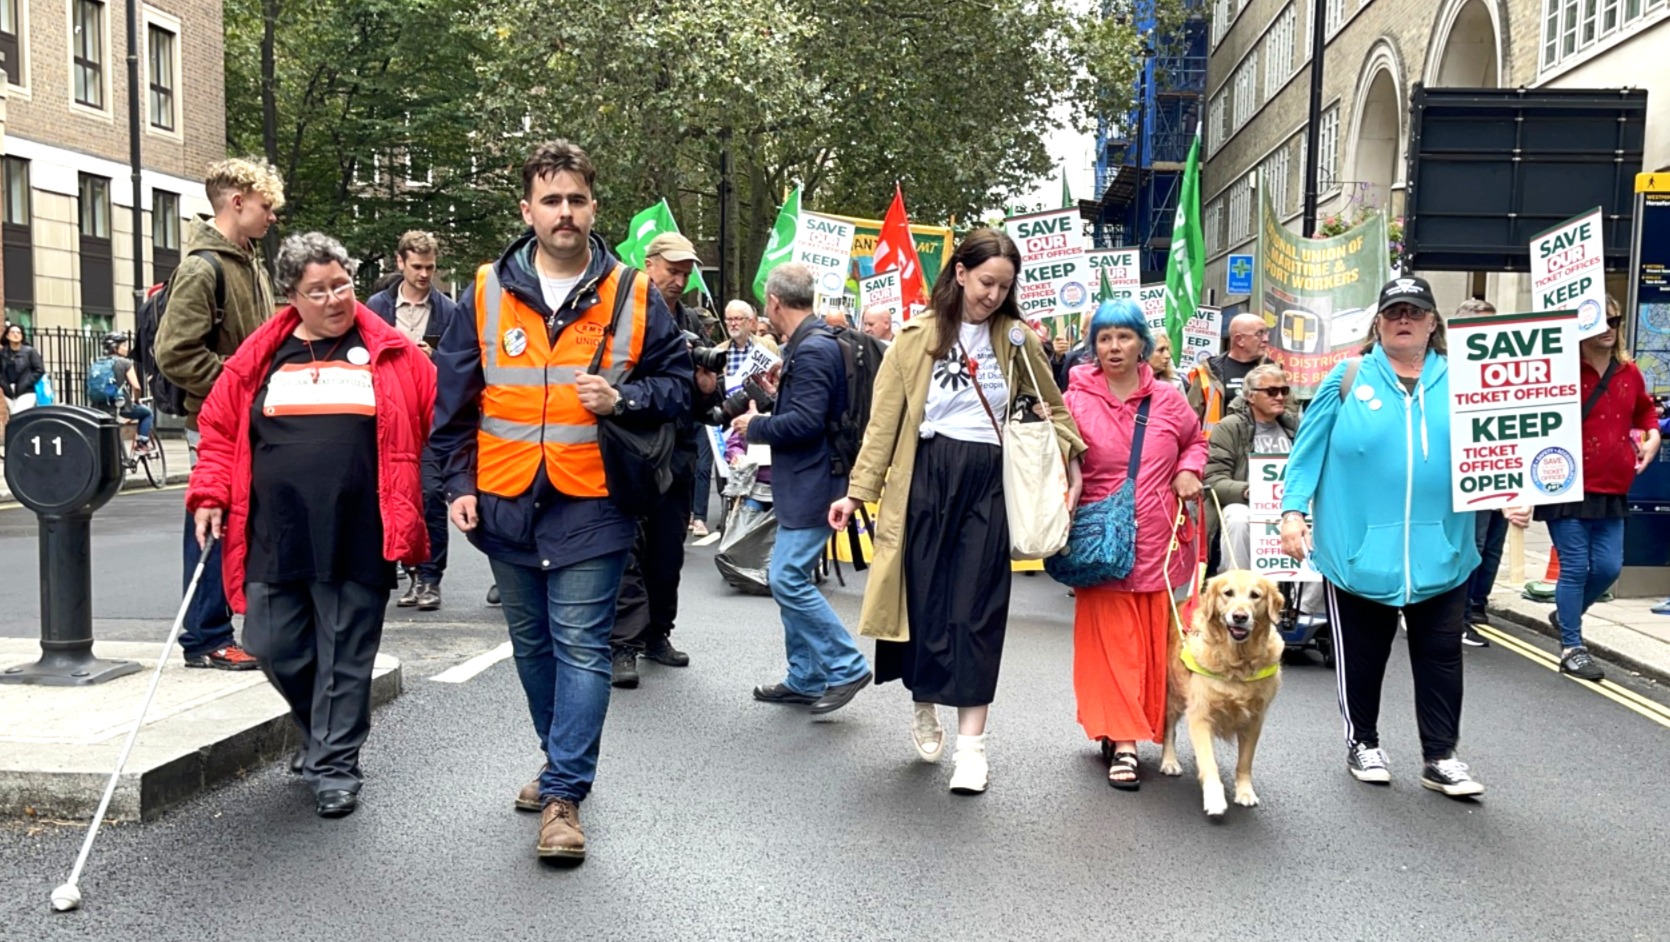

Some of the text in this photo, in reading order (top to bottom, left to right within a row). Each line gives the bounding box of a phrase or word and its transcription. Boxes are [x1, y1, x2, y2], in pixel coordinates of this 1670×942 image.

[806, 219, 847, 237] SAVE
[1017, 216, 1072, 239] SAVE
[1028, 236, 1065, 252] OUR
[1301, 245, 1346, 263] UNION
[1348, 235, 1364, 255] OF
[1540, 222, 1592, 259] SAVE
[801, 251, 840, 267] KEEP
[1022, 247, 1083, 262] CKET OFFICES
[1089, 254, 1132, 268] SAVE
[1271, 246, 1330, 277] MARITIME
[1334, 259, 1346, 273] &
[1548, 246, 1584, 272] OUR
[1024, 262, 1076, 283] KEEP
[1291, 268, 1359, 291] WORKERS
[1535, 256, 1601, 288] TICKET OFFICES
[865, 275, 895, 292] SAVE
[1023, 282, 1052, 292] TICKET
[1543, 276, 1592, 309] KEEP
[1020, 289, 1056, 300] OFFICES
[1140, 288, 1165, 301] SAV
[1021, 297, 1057, 311] OPEN
[575, 336, 600, 347] UNIO
[1187, 336, 1210, 347] EEP
[1466, 327, 1563, 361] SAVE
[751, 350, 772, 369] SAVE
[1484, 359, 1549, 387] OUR
[1455, 384, 1577, 405] TICKET OFFICES
[1472, 411, 1562, 443] KEEP
[1462, 444, 1518, 459] TICKET
[1459, 457, 1523, 473] OFFICES
[1543, 457, 1563, 465] SAVE
[1460, 472, 1524, 493] OPEN
[1256, 557, 1301, 570] OPEN
